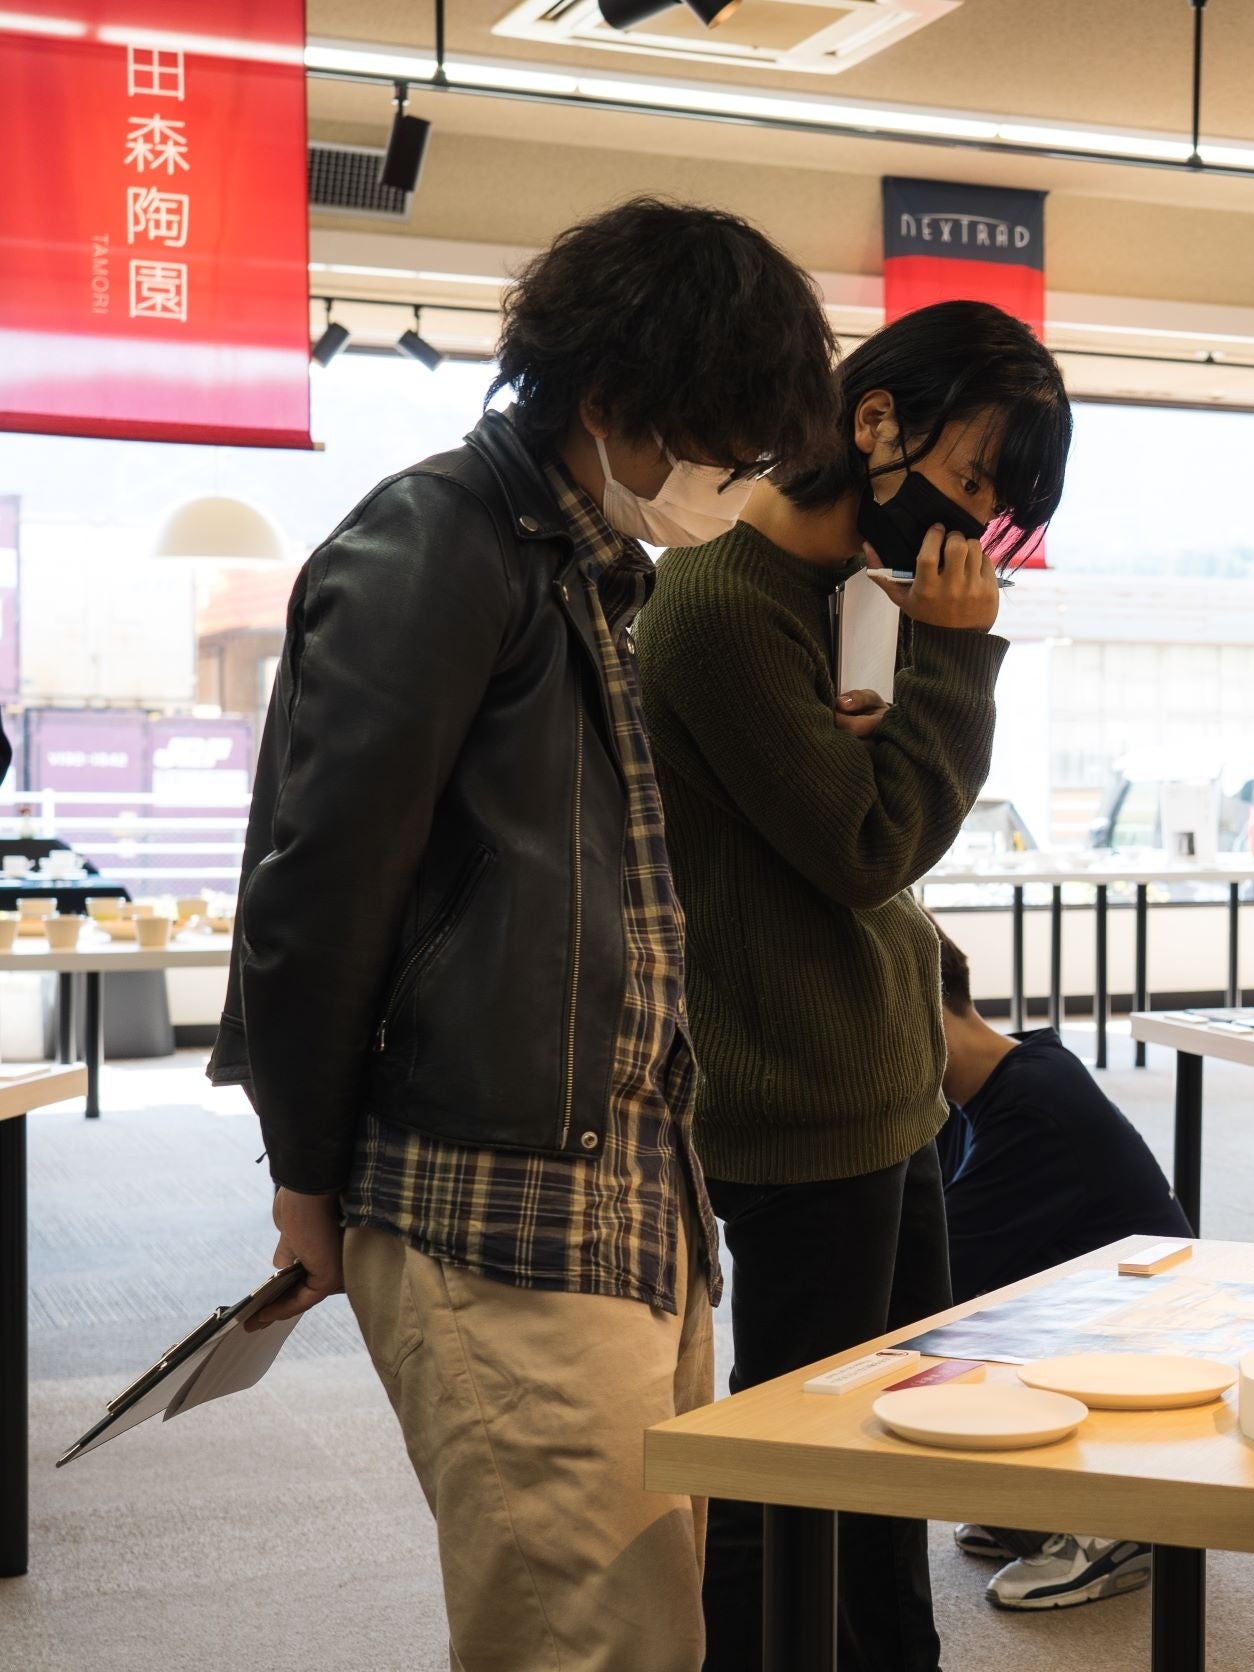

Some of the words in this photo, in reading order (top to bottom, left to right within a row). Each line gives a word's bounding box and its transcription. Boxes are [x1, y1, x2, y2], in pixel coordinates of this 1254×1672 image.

[124, 43, 190, 323] 田森陶園
[91, 233, 110, 315] TAMORI
